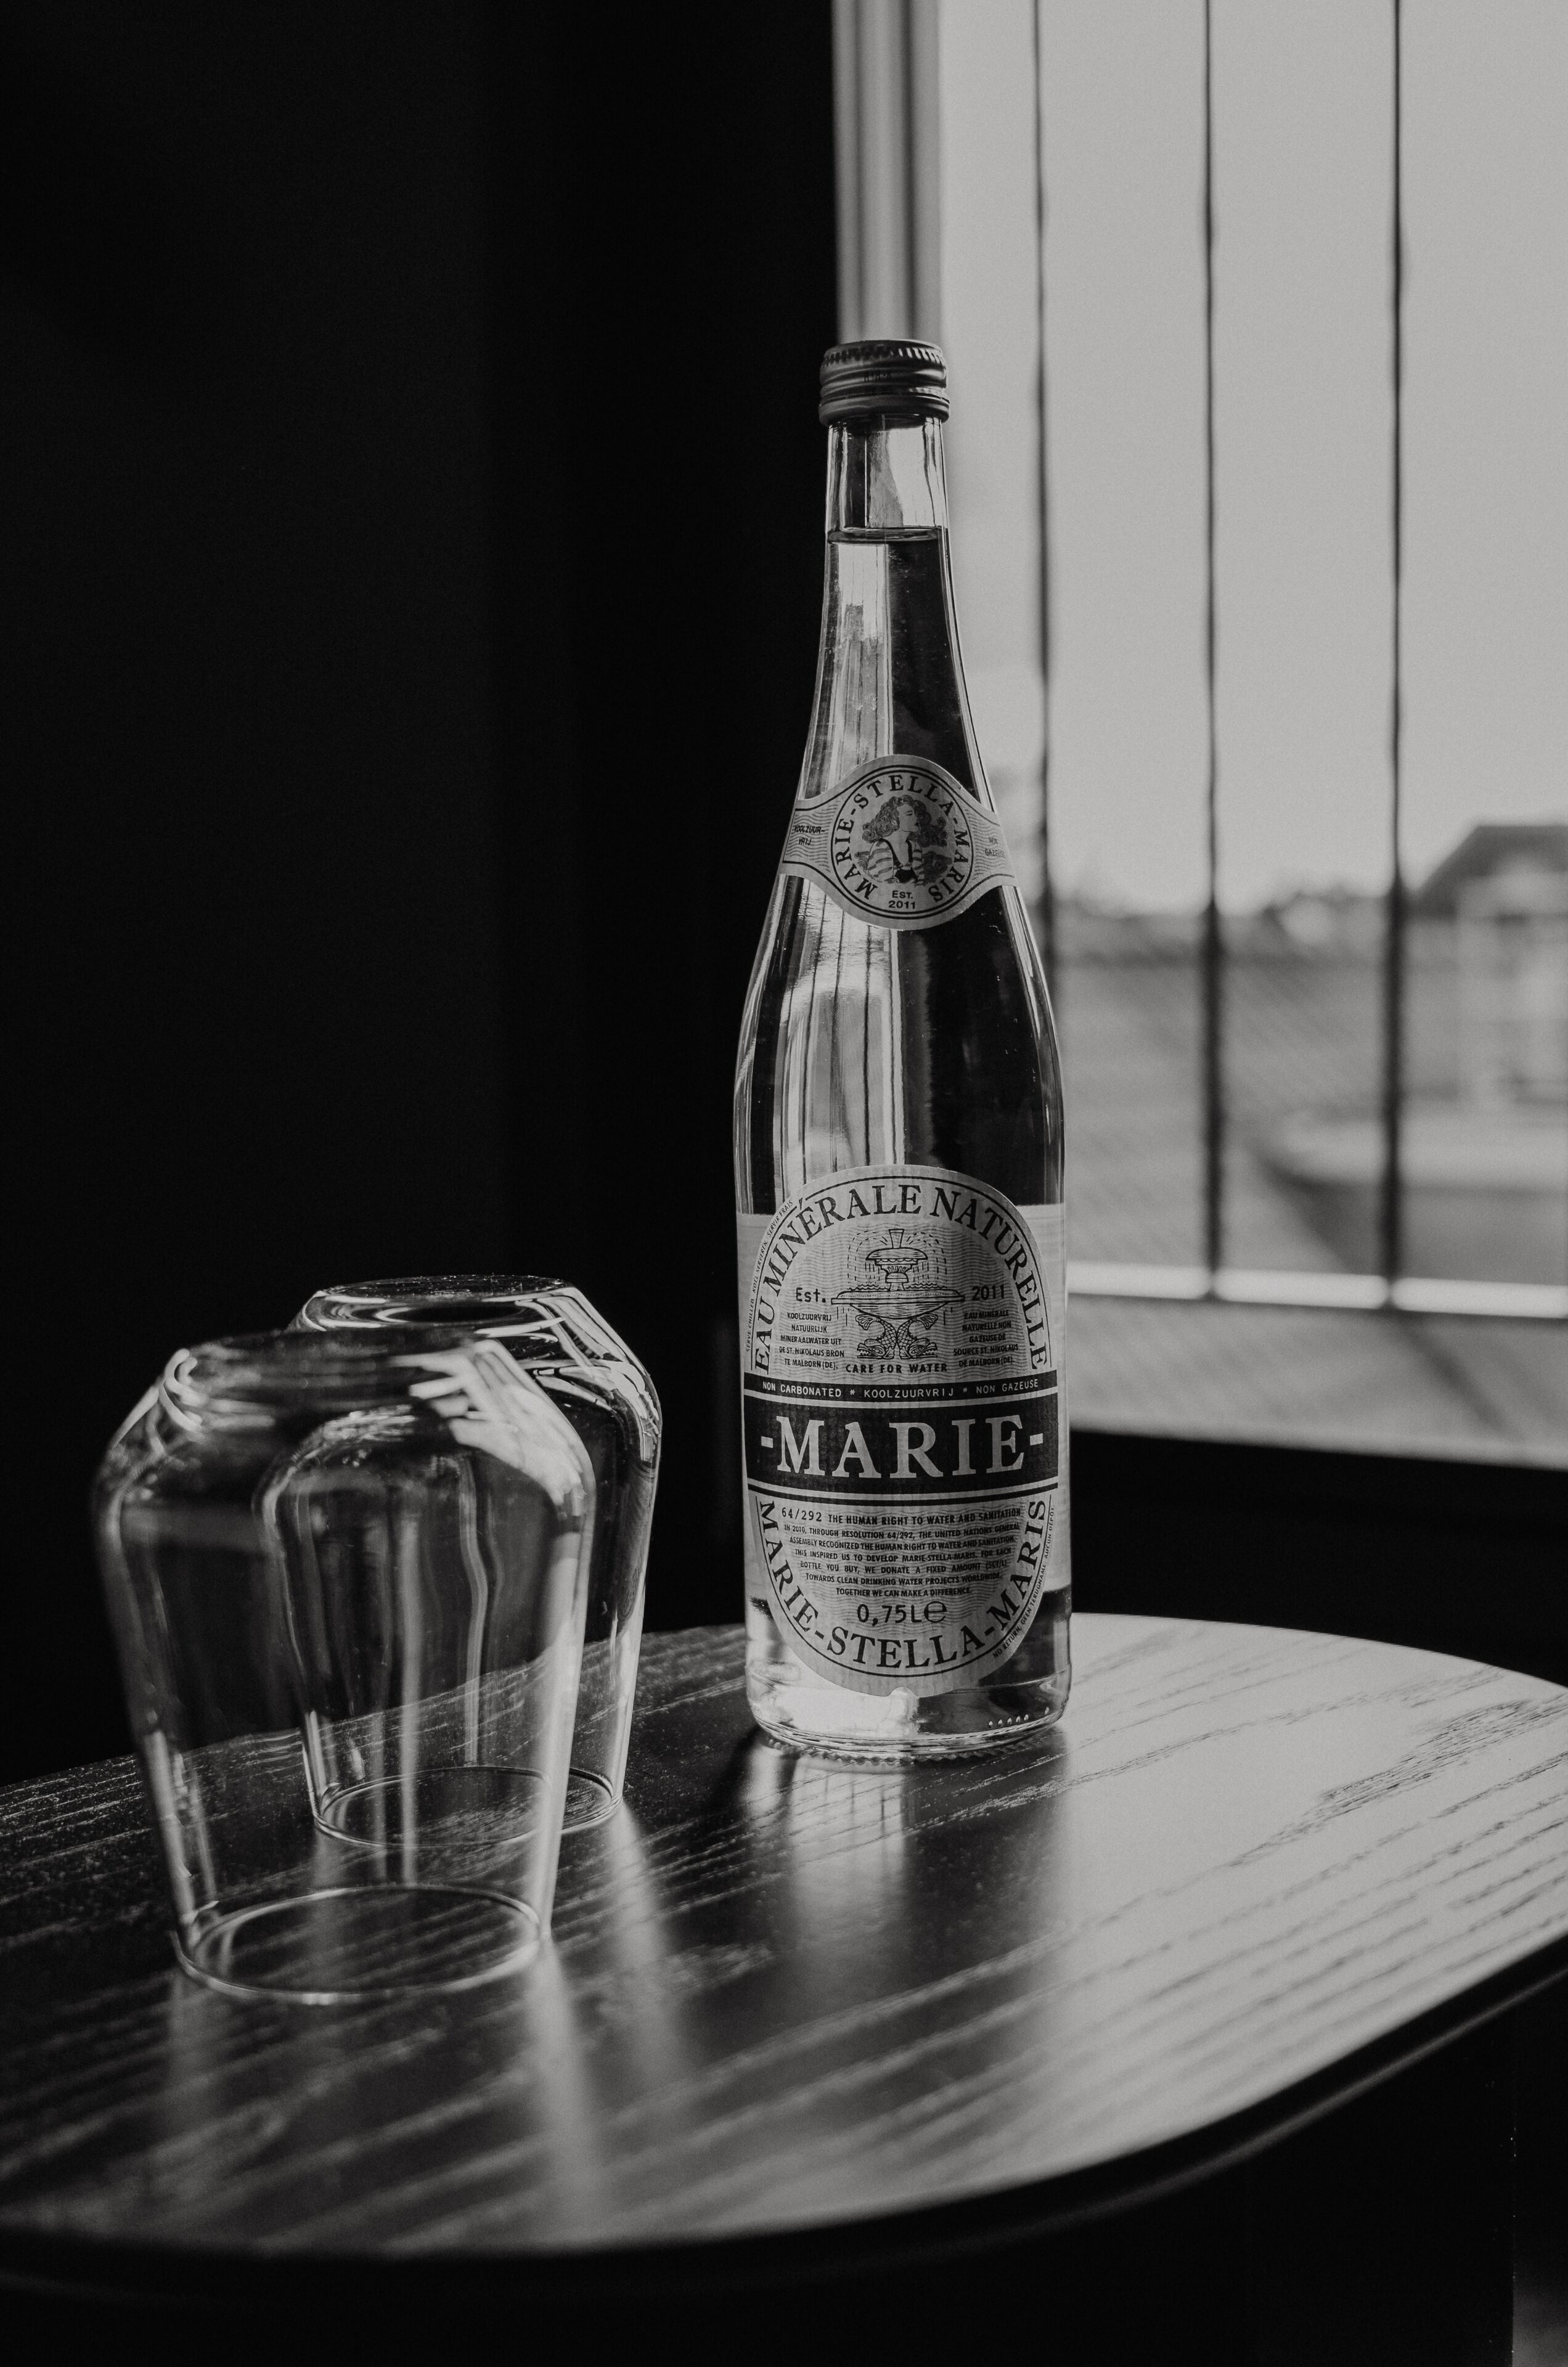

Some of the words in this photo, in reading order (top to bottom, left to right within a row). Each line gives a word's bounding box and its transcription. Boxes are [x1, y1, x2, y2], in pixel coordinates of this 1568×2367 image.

[891, 890, 913, 899] EST.
[888, 901, 916, 909] 2011
[767, 1216, 780, 1238] SERVIR
[778, 1200, 793, 1217] FRAIS
[763, 1184, 921, 1298] MINÉRALE
[929, 1187, 1047, 1370] NATURELLE
[795, 1286, 827, 1303] Est.
[972, 1284, 1005, 1301] 2011
[787, 1312, 832, 1321] KOOLZUURVRIJ
[791, 1324, 828, 1333] NATUURLIJK
[962, 1322, 997, 1331] NATURELLE
[755, 1295, 775, 1375] EAU
[780, 1335, 829, 1344] MINERAALWATER
[969, 1334, 997, 1343] GAZEUSE
[795, 1347, 824, 1356] NIKOLAUS
[953, 1347, 979, 1356] SOURCE
[990, 1344, 1018, 1353] NIKOLAUS
[792, 1359, 821, 1368] MALBORN
[822, 1361, 838, 1370] (DE).
[846, 1364, 873, 1373] CARE
[880, 1364, 902, 1373] FOR
[909, 1363, 947, 1372] WATER
[969, 1357, 1000, 1367] MALBORN
[762, 1381, 775, 1391] NON
[780, 1384, 841, 1397] CARBONATED
[864, 1388, 953, 1398] KOOLZUURVRIJ
[976, 1385, 995, 1394] NON
[1002, 1379, 1039, 1392] GAZEUSE
[782, 1507, 822, 1522] 64/292
[828, 1514, 843, 1523] THE
[846, 1515, 877, 1525] HUMAN
[881, 1517, 908, 1525] RIGHT
[912, 1516, 923, 1524] TO
[927, 1515, 955, 1524] WATER
[958, 1513, 976, 1523] AND
[979, 1508, 1021, 1521] SANITATION
[793, 1526, 807, 1534] 2010,
[809, 1527, 839, 1537] THROUGH
[842, 1531, 884, 1539] RESOLUTION
[887, 1532, 915, 1540] 64/292,
[934, 1530, 961, 1538] UNITED
[963, 1527, 992, 1536] NATIONS
[995, 1523, 1020, 1532] GENERAL
[790, 1537, 817, 1547] ASSEMBLY
[819, 1540, 859, 1550] RECOGNIZED
[963, 1539, 977, 1547] AND
[794, 1548, 807, 1556] THIS
[810, 1551, 838, 1560] INSPIRED
[981, 1550, 993, 1558] FOR
[996, 1547, 1011, 1555] EACH
[800, 1561, 822, 1569] BOTTLE
[844, 1566, 860, 1574] BUY,
[951, 1563, 981, 1572] AMOUNT
[759, 1500, 1047, 1669] MARIE-STELLA-MARIS
[806, 1573, 835, 1582] TOWARDS
[837, 1576, 858, 1584] CLEAN
[860, 1577, 897, 1585] DRINKING
[925, 1576, 959, 1585] PROJECTS
[962, 1572, 1002, 1583] WORLDWIDE.
[836, 1588, 870, 1596] TOGETHER
[930, 1587, 972, 1596] DIFFERENCE.
[992, 1648, 1002, 1658] NO
[1021, 1607, 1032, 1625] GEEN
